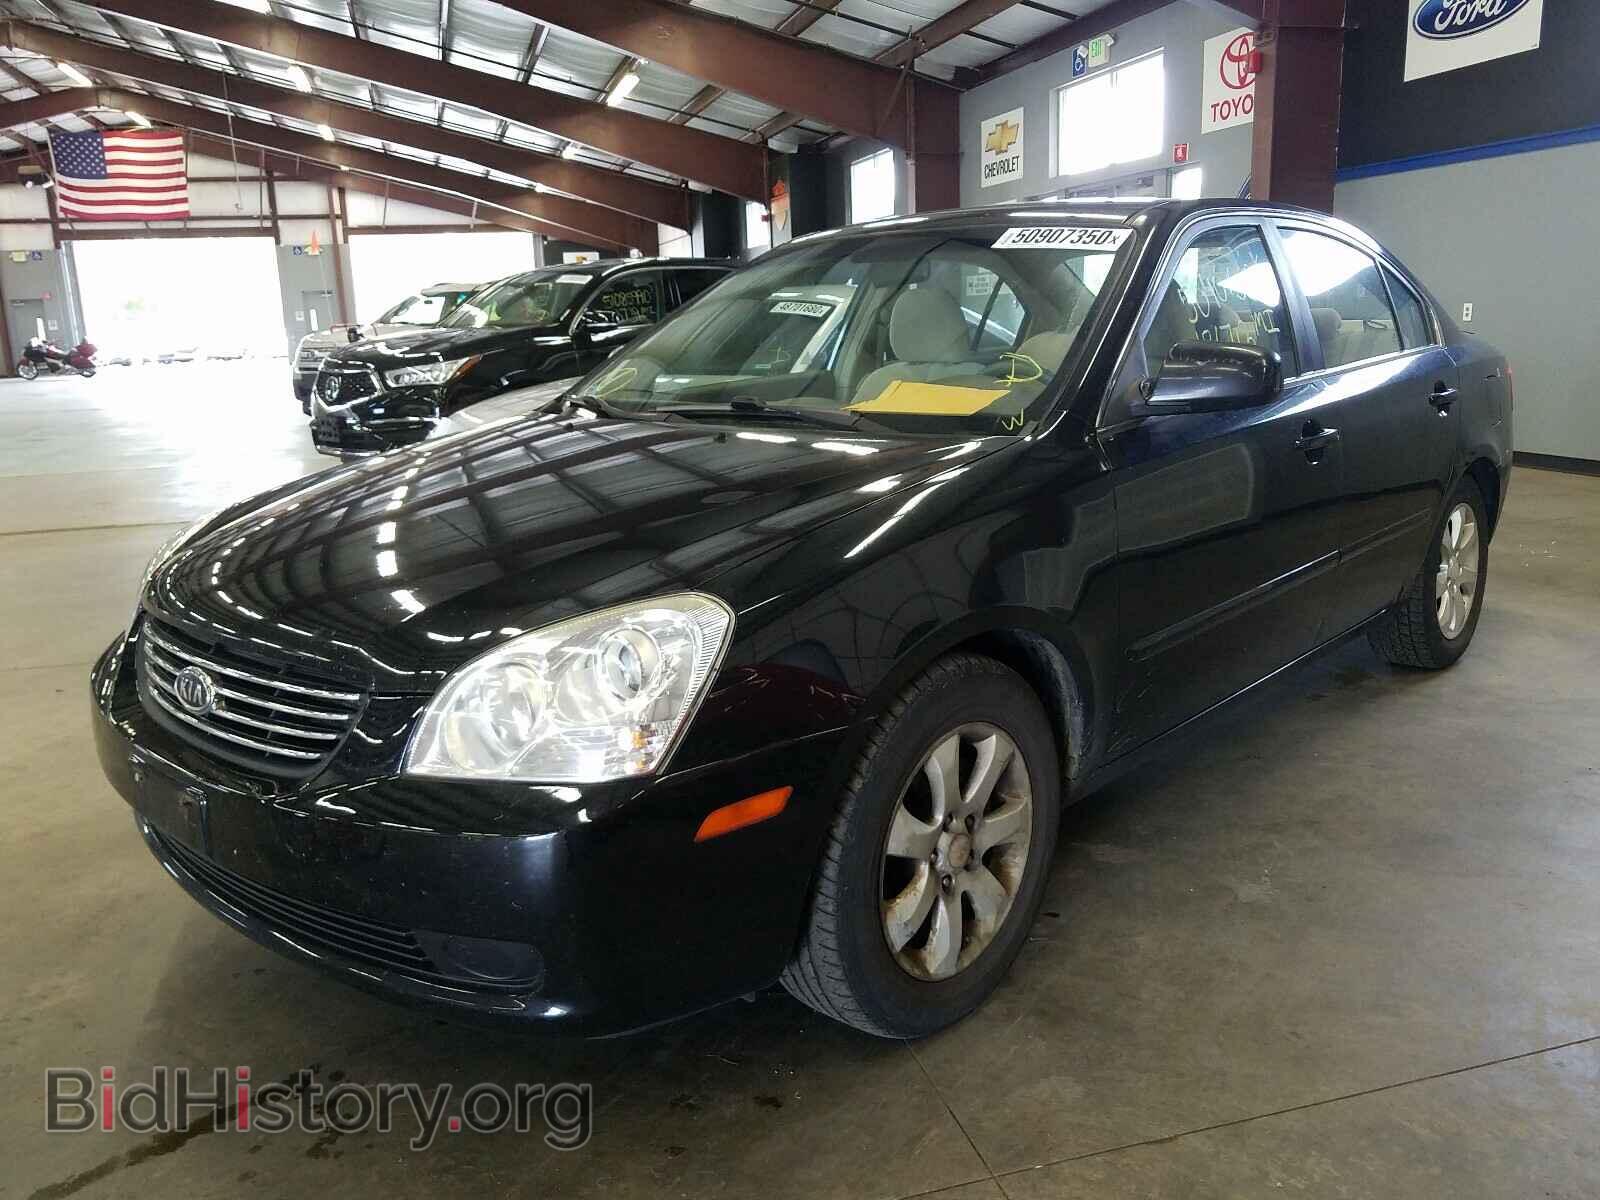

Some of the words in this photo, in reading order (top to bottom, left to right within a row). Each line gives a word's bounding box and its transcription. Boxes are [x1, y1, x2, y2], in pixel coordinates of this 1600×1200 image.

[1434, 0, 1507, 31] Ford
[1211, 94, 1254, 122] TOYO
[984, 155, 1020, 179] CHEVROLET
[180, 677, 203, 706] KIA
